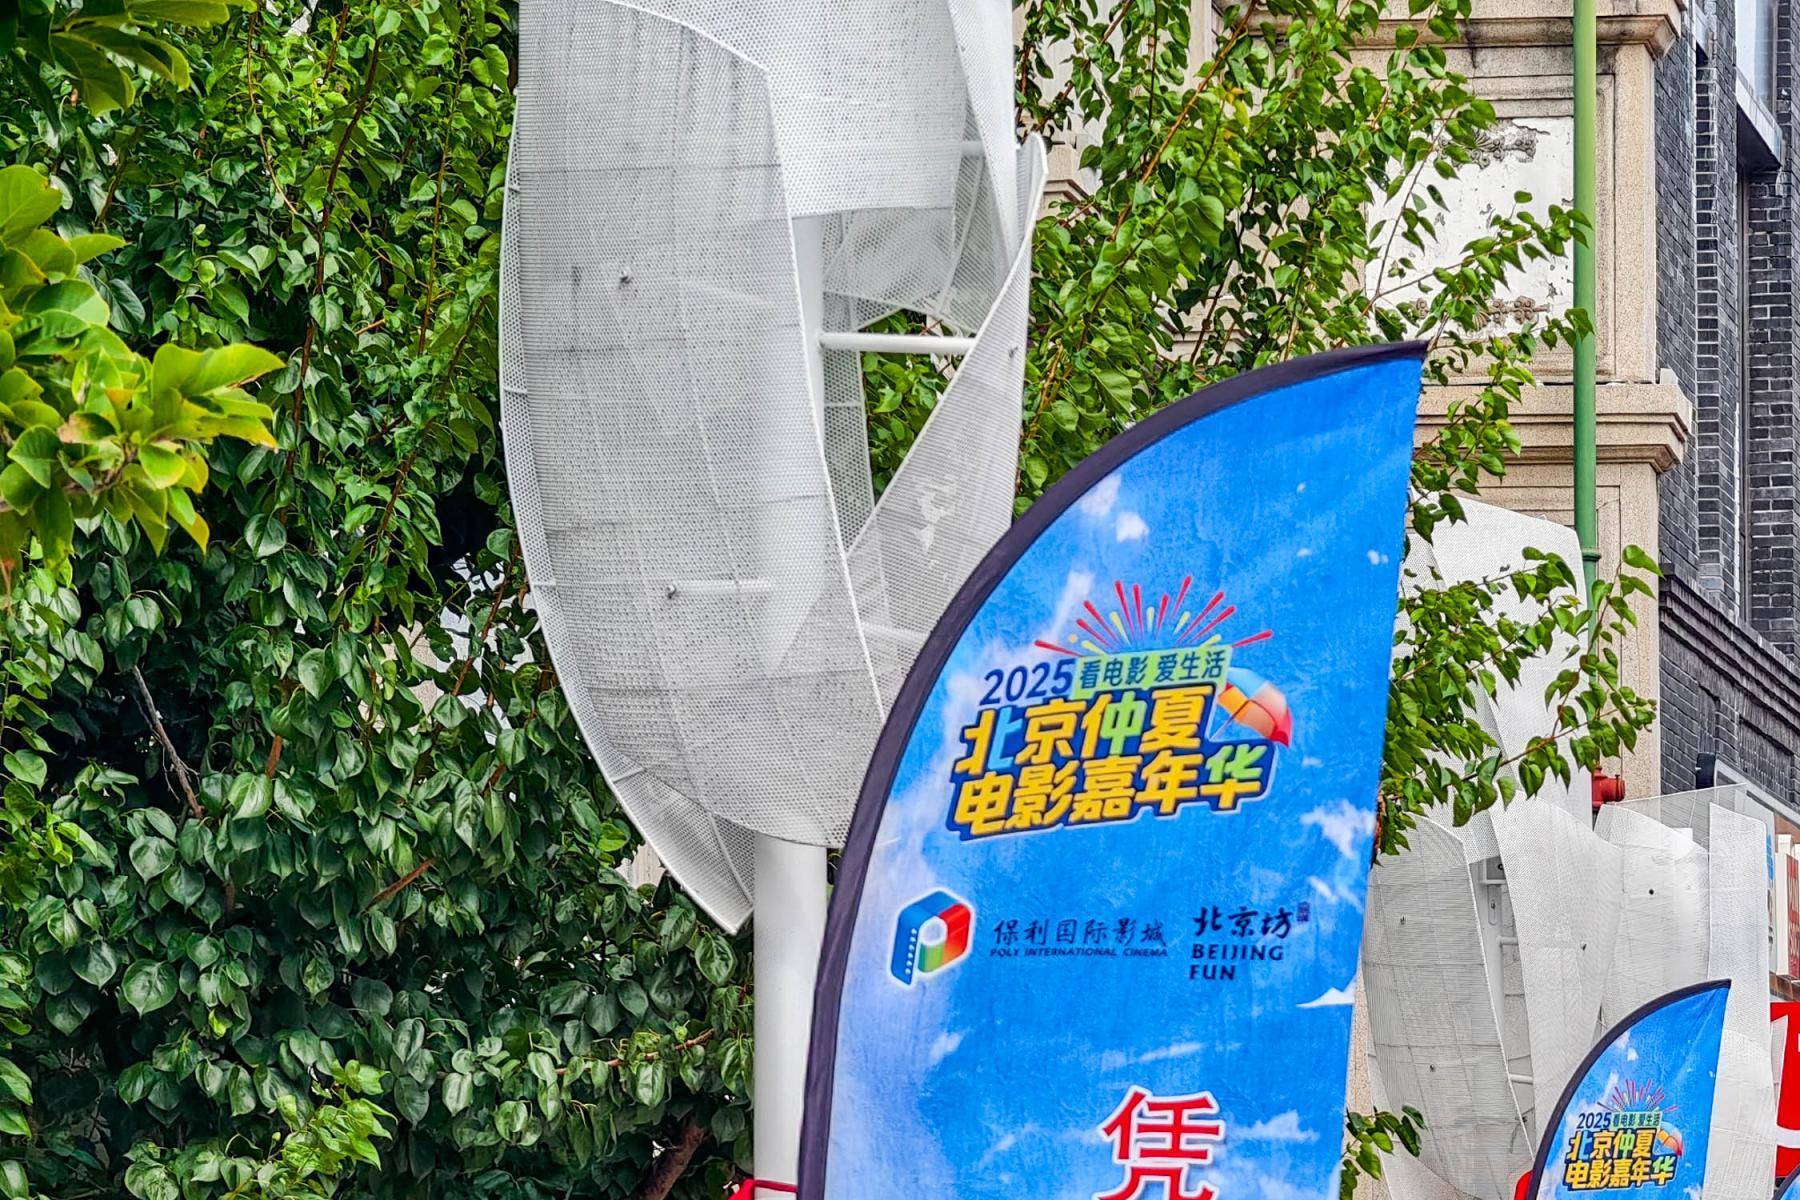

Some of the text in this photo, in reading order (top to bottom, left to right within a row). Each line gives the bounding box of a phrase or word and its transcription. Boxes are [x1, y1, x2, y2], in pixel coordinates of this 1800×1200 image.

[980, 649, 1226, 706] 2025 看电影 爱生活
[954, 684, 1211, 775] 北京仲夏
[953, 743, 1268, 836] 电影嘉年华
[993, 915, 1168, 946] 保利国际影城
[1191, 905, 1294, 939] 北京坊
[989, 946, 1169, 958] POLY INTERNATIONAL CINEMA
[1191, 943, 1284, 961] BEIJING
[1188, 964, 1237, 981] FUN
[1576, 1112, 1611, 1129] 2025
[1566, 1129, 1656, 1161] 北京仲夏
[1566, 1156, 1675, 1189] 电影嘉年华
